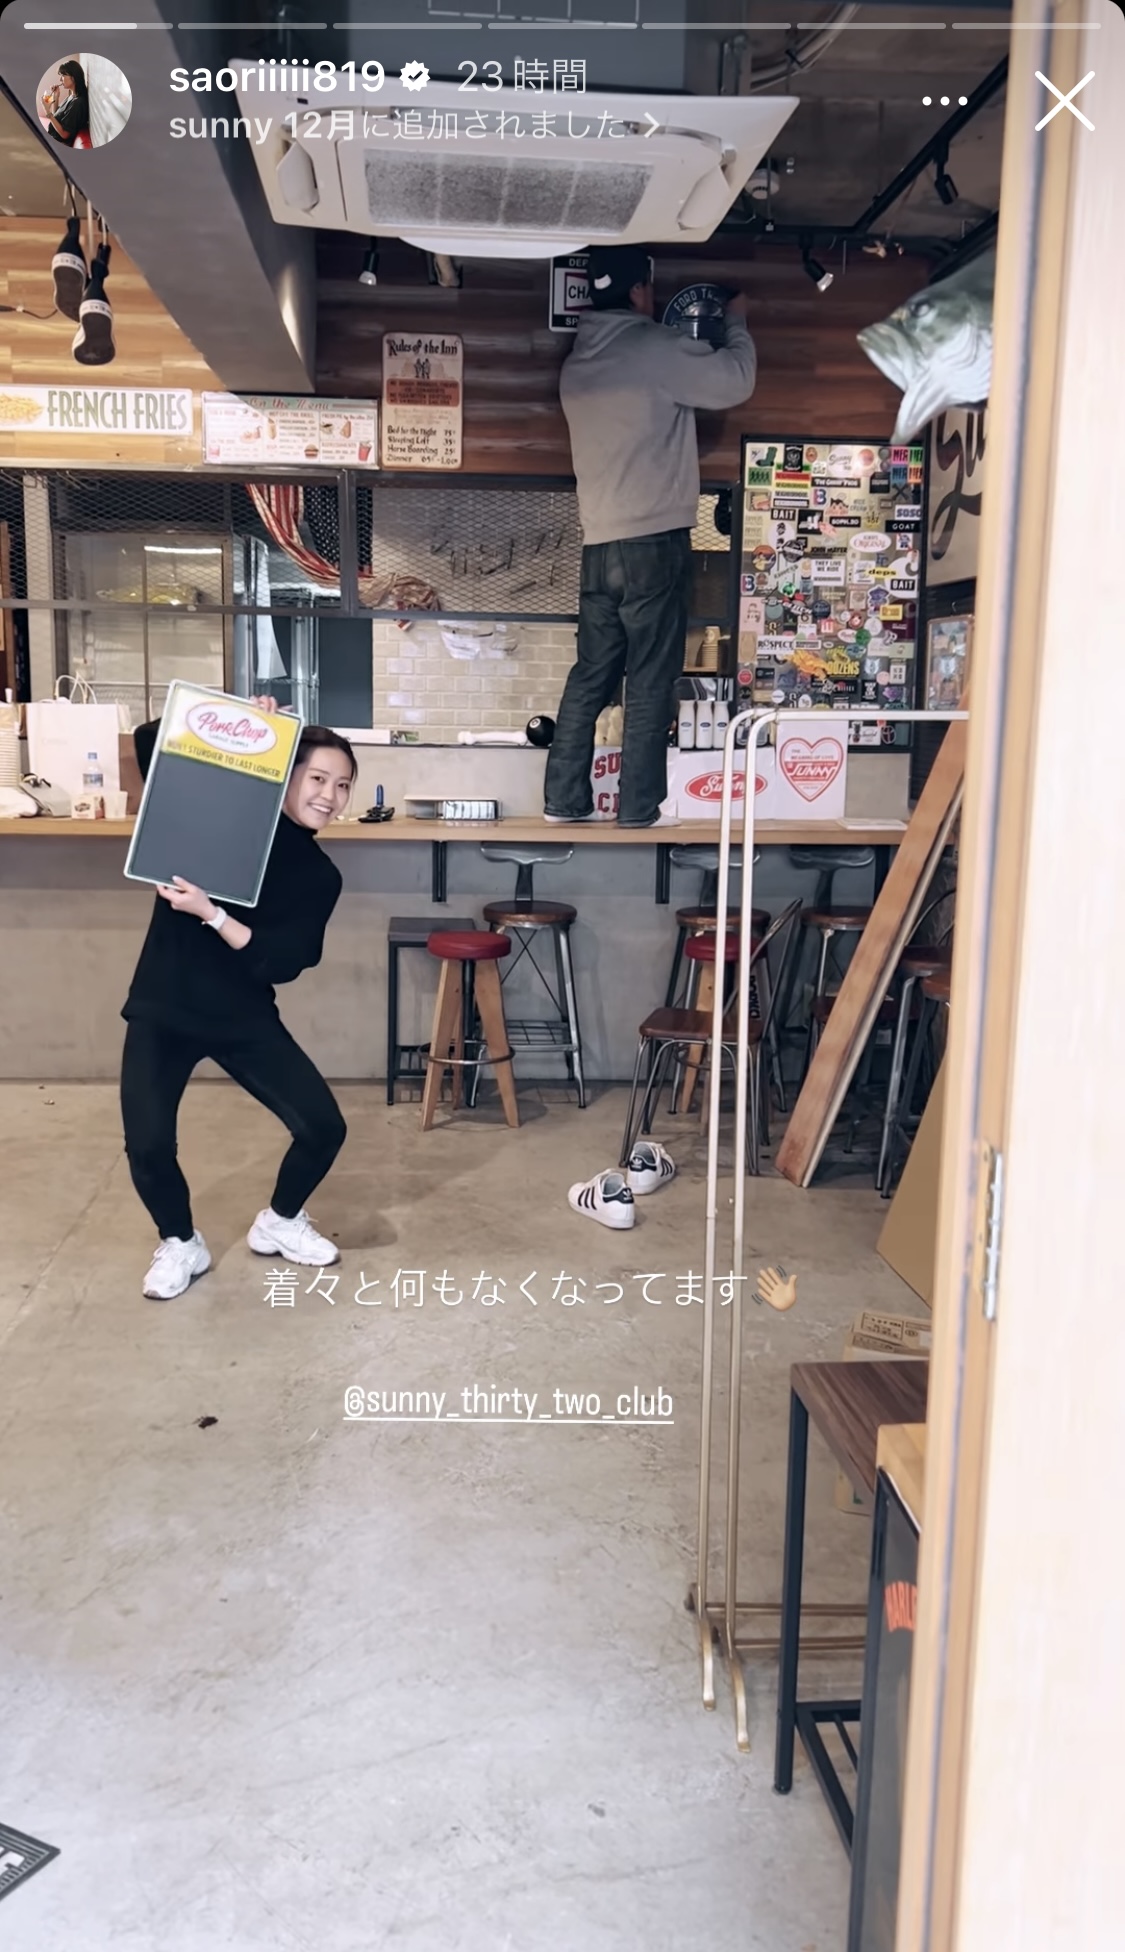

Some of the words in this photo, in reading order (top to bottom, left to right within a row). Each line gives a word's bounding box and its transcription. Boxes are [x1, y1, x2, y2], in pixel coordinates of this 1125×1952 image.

[673, 290, 698, 312] FORD
[387, 339, 411, 356] Rules
[424, 340, 440, 354] the
[440, 339, 458, 354] Inn
[47, 390, 127, 429] FRENCH
[133, 393, 187, 430] FRIES
[772, 510, 795, 519] BAIT
[892, 580, 914, 589] BAIT
[198, 711, 233, 736] Pork
[233, 718, 268, 743] Chop
[224, 754, 234, 765] TO
[235, 756, 253, 770] LAST
[253, 762, 281, 778] LONGER
